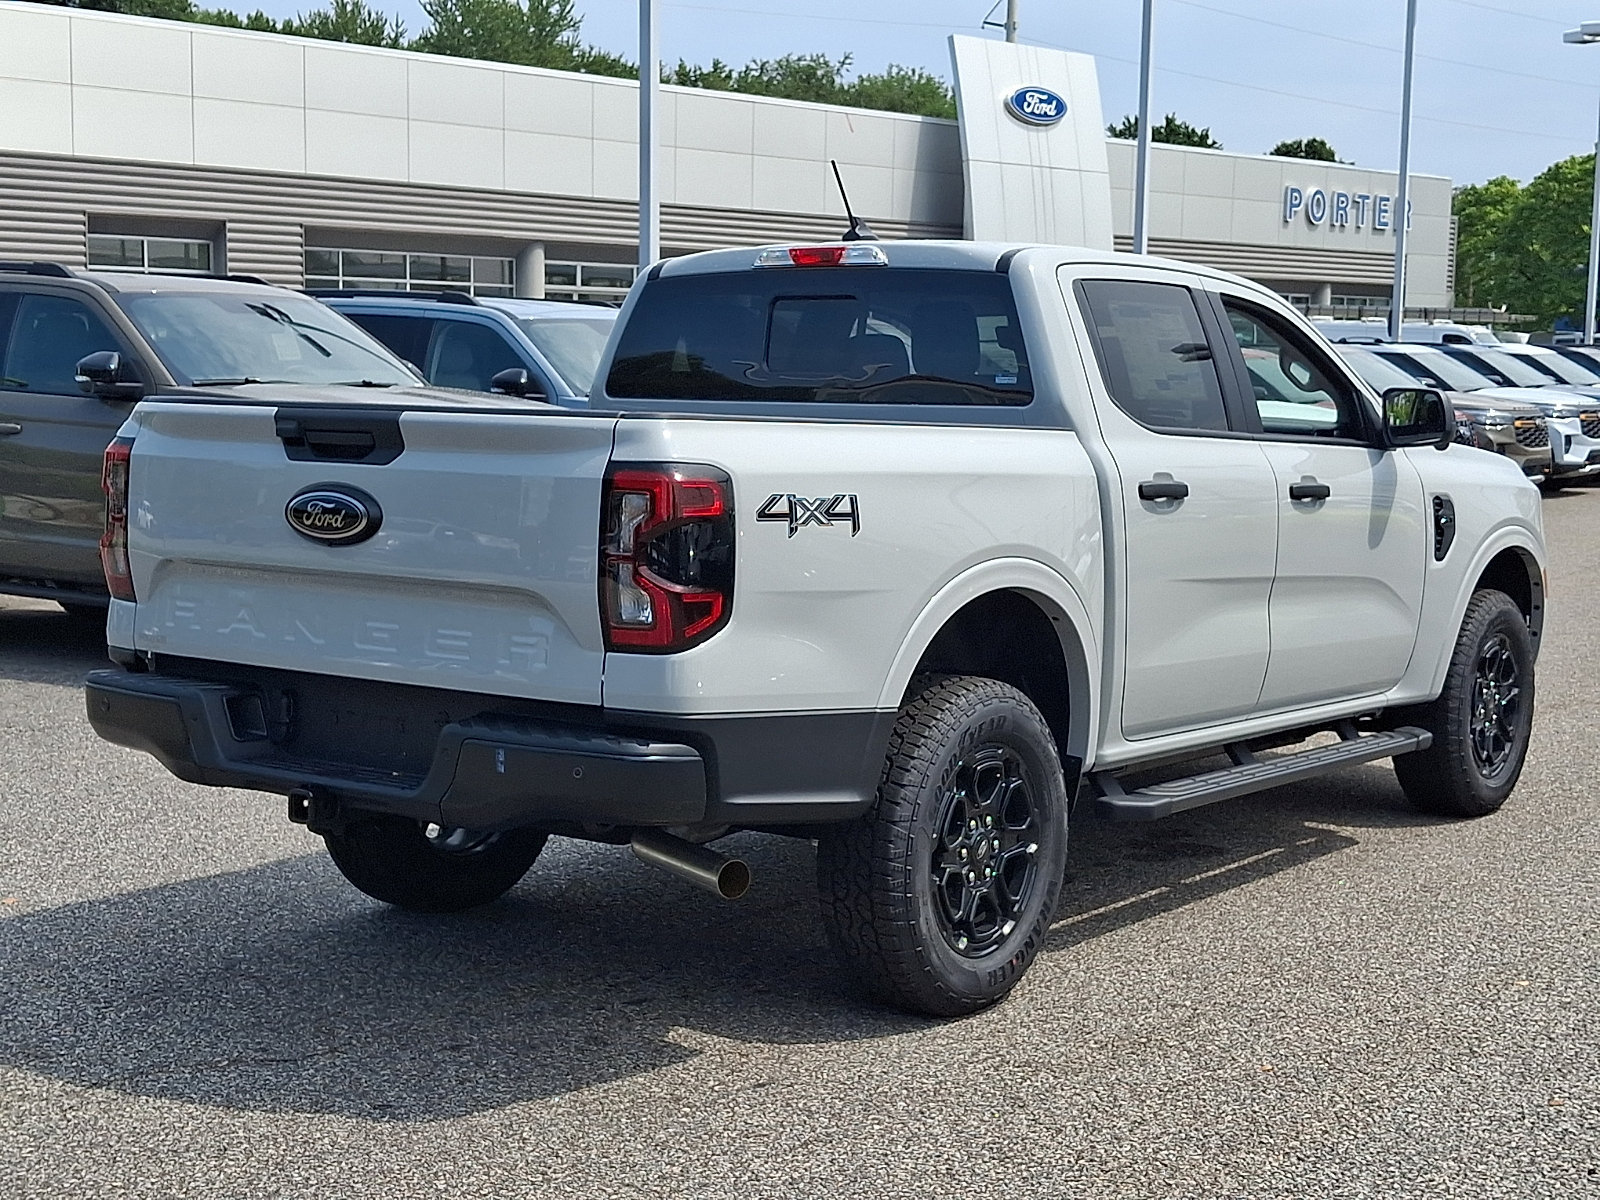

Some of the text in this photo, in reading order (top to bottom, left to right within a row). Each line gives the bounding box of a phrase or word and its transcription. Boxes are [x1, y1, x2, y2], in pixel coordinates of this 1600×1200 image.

[1023, 91, 1057, 116] Ford
[303, 501, 346, 528] Ford
[756, 494, 860, 538] 4x4
